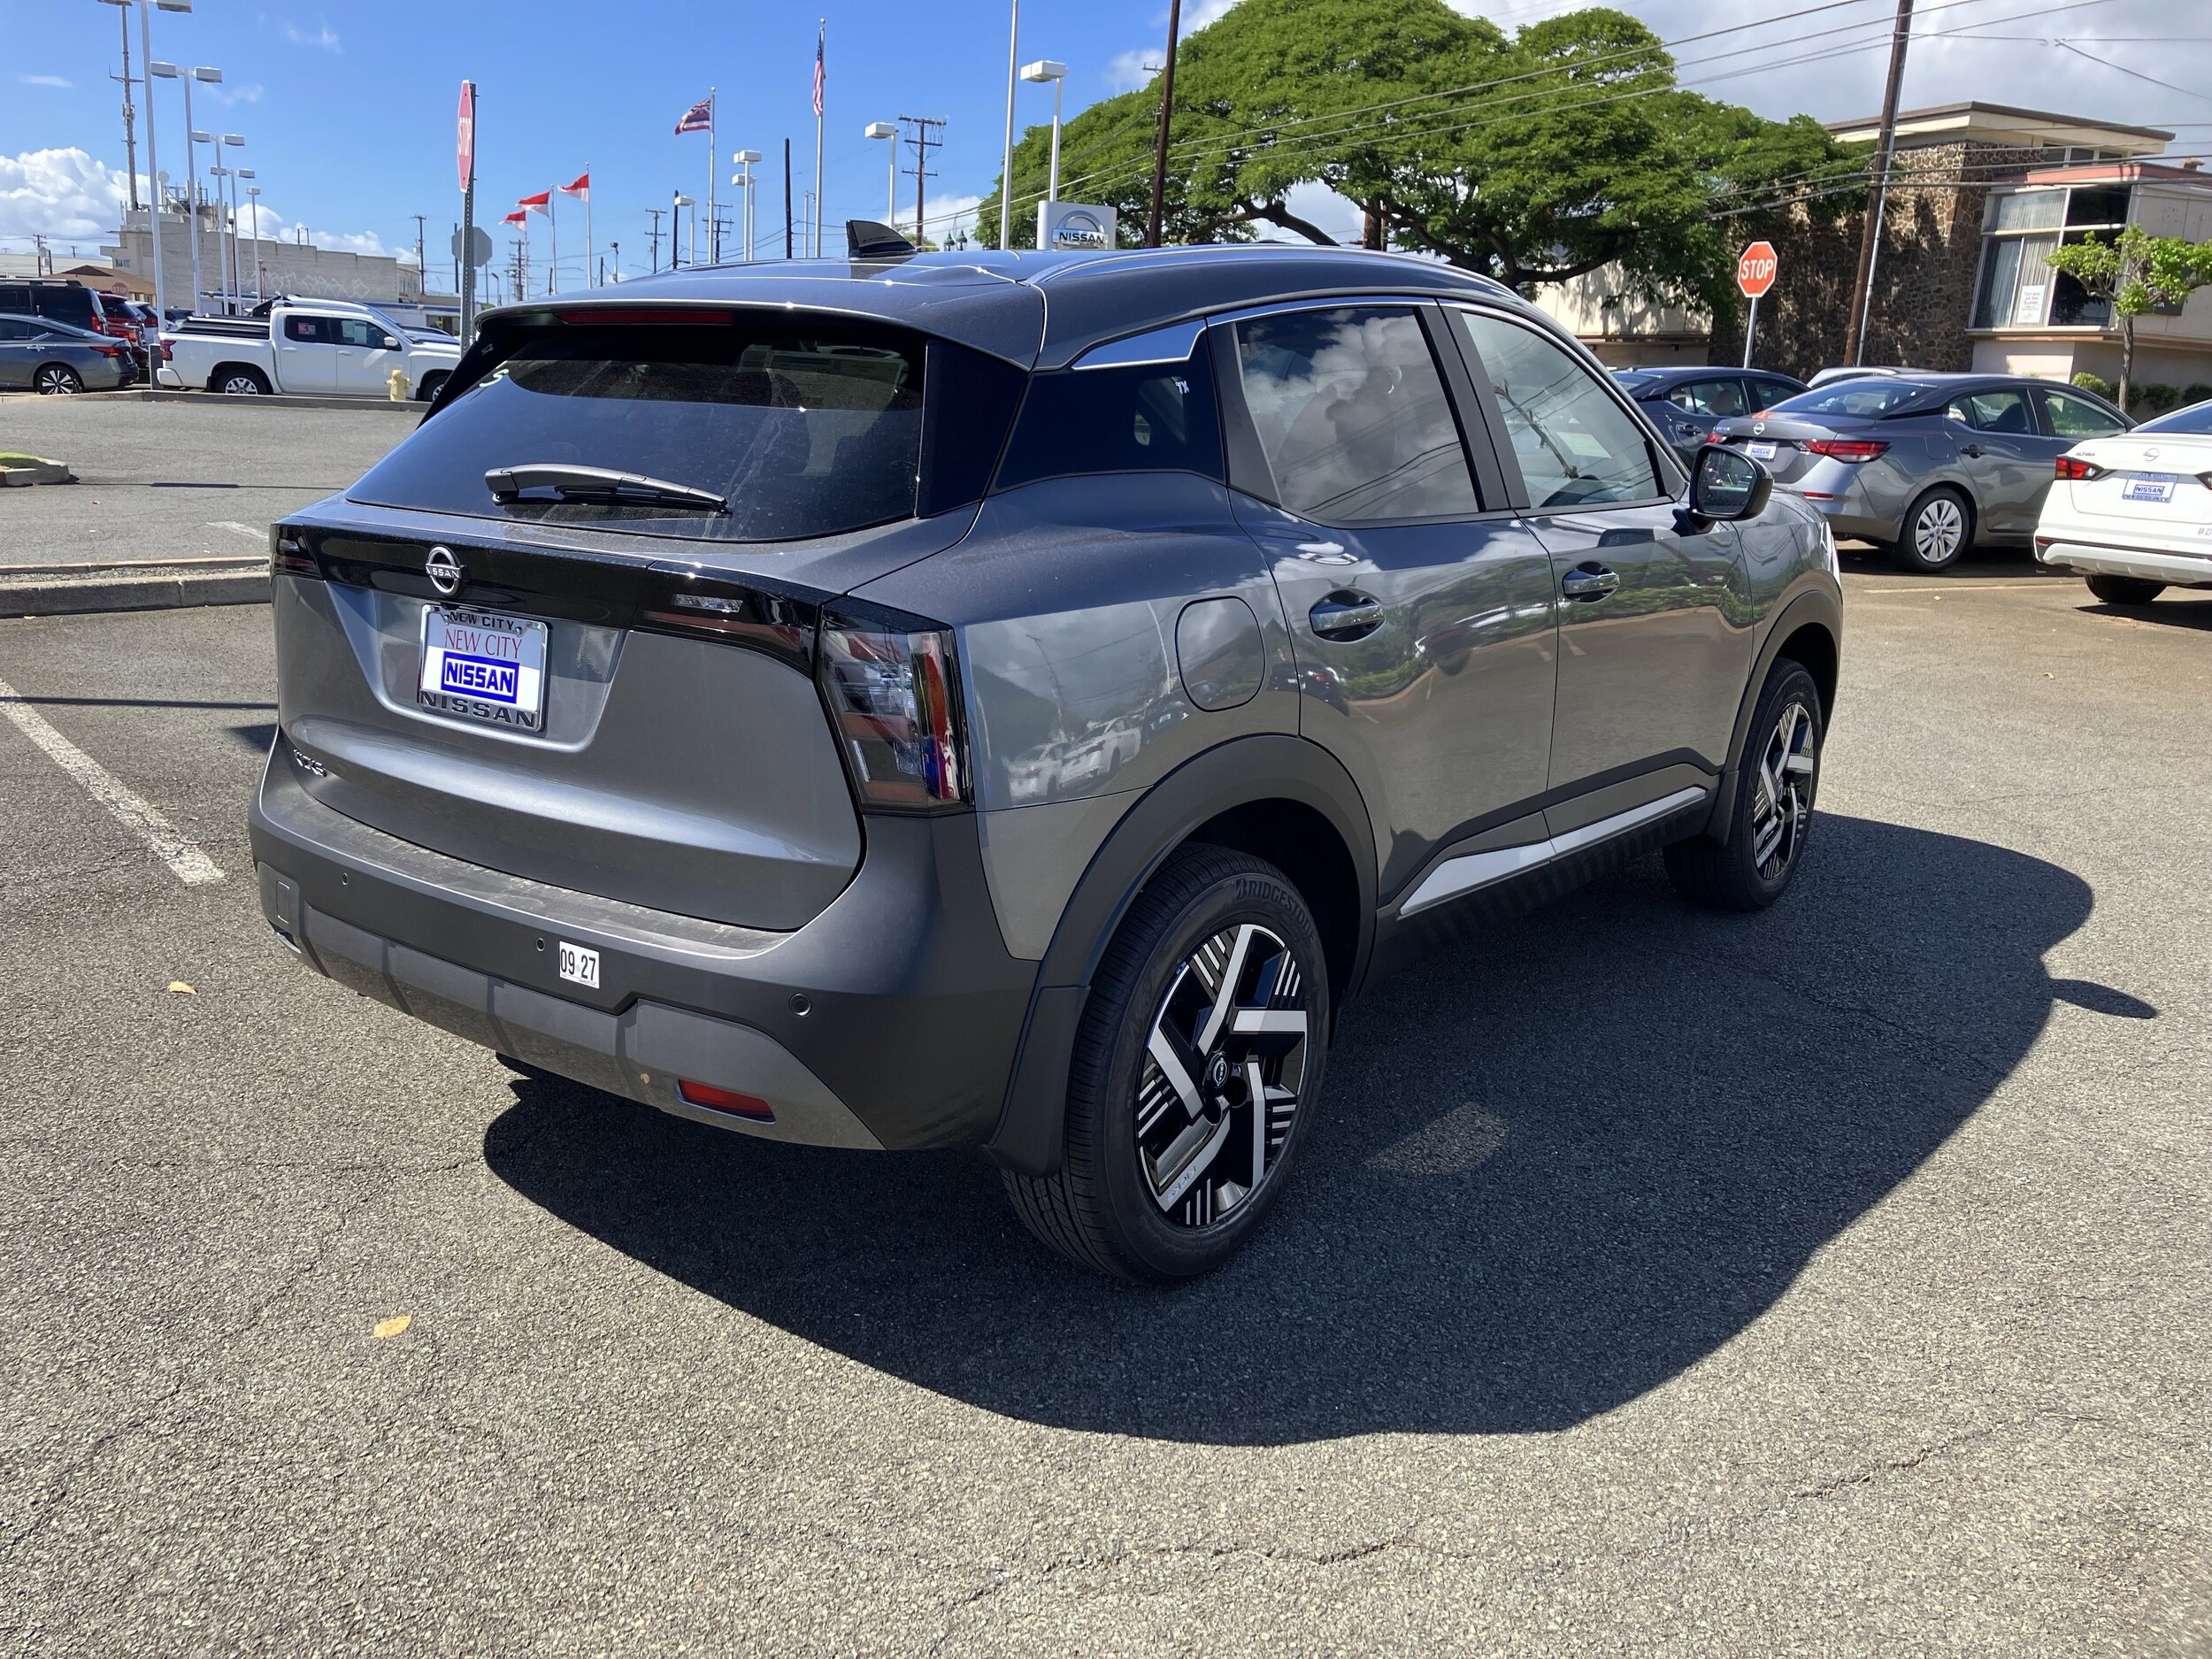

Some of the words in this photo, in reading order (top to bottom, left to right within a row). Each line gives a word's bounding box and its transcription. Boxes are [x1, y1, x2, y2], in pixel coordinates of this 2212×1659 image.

[458, 117, 471, 156] STOP
[1059, 232, 1104, 243] NISSAN
[1741, 259, 1774, 280] STOP
[426, 565, 459, 579] NISSAN
[449, 611, 478, 625] NEW
[481, 616, 515, 631] CITY
[444, 628, 481, 652] NEW
[485, 634, 522, 659] CITY
[446, 662, 513, 693] NISSAN
[420, 691, 534, 727] NISSAN
[1235, 877, 1316, 946] BRIDGESTONE
[560, 948, 575, 975] 09
[580, 954, 596, 981] 27
